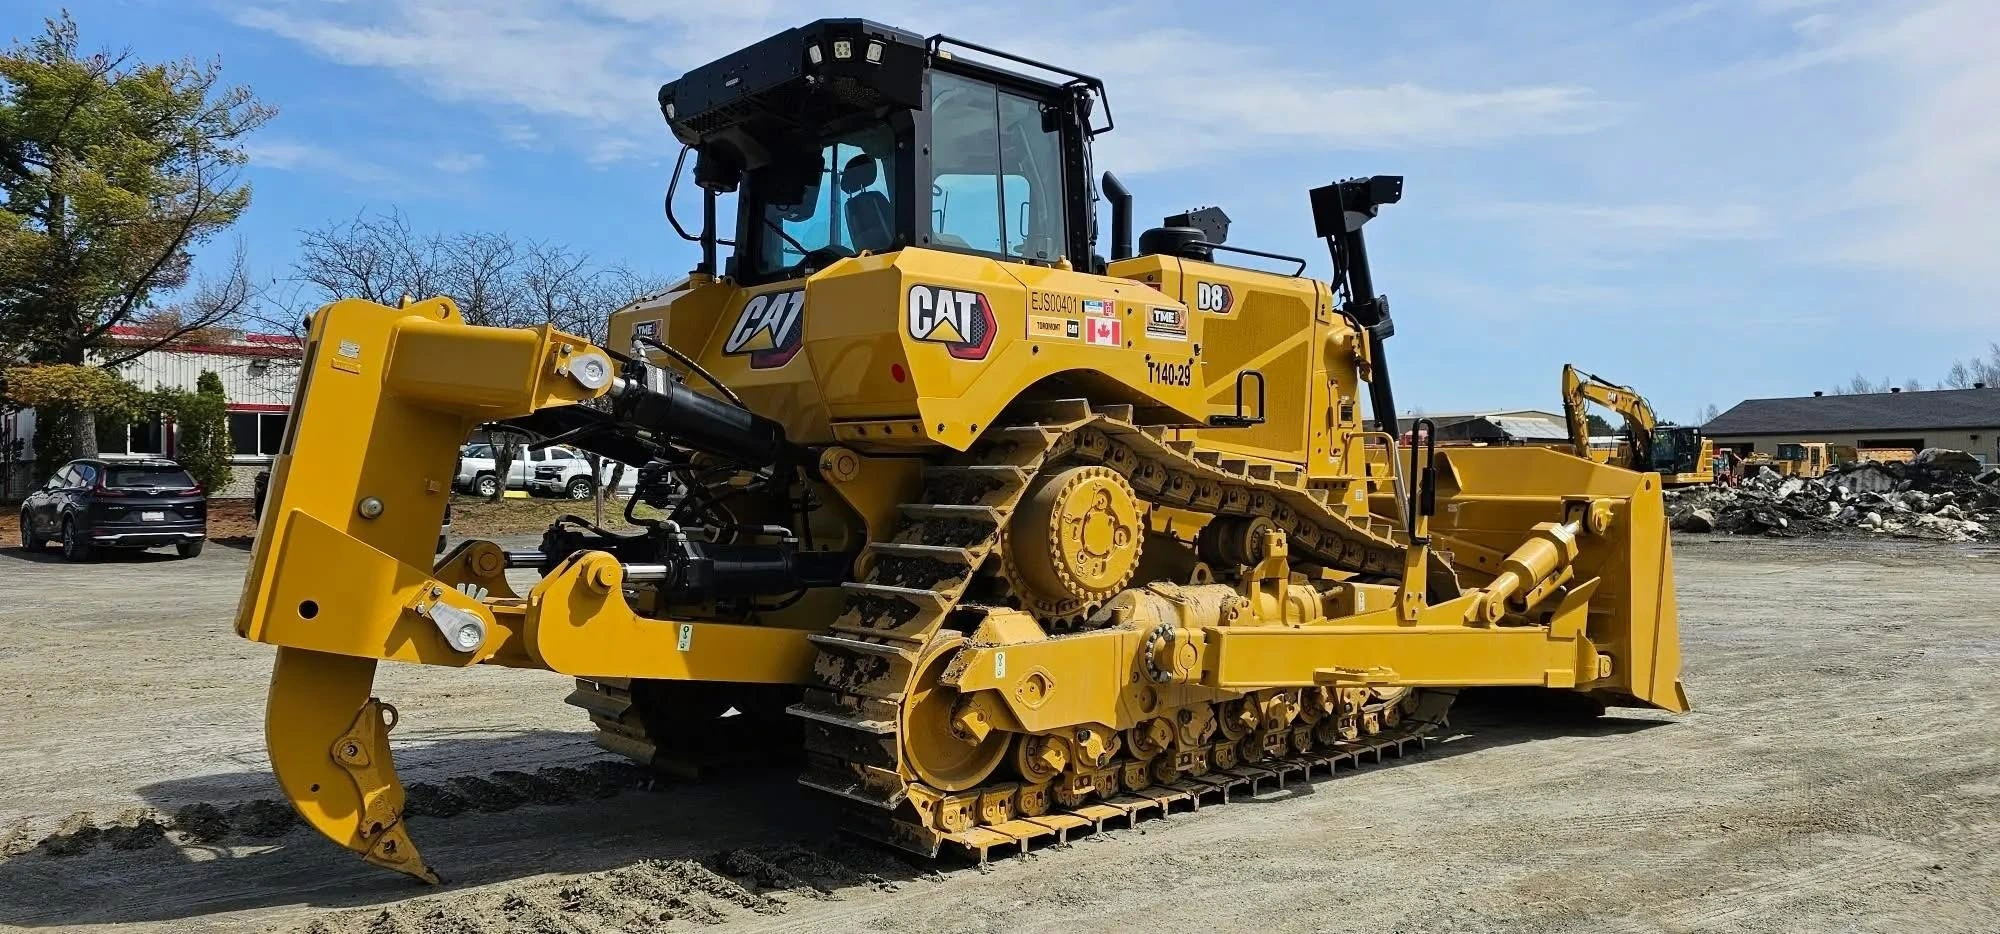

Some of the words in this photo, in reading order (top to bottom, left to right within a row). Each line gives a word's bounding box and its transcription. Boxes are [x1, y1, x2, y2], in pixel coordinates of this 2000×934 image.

[1031, 291, 1077, 314] EJS00401
[1198, 282, 1224, 312] D8
[725, 290, 805, 353] CAT
[909, 285, 977, 343] CAT
[1153, 310, 1175, 324] TME
[637, 324, 653, 335] TME
[1147, 361, 1191, 387] T140-29
